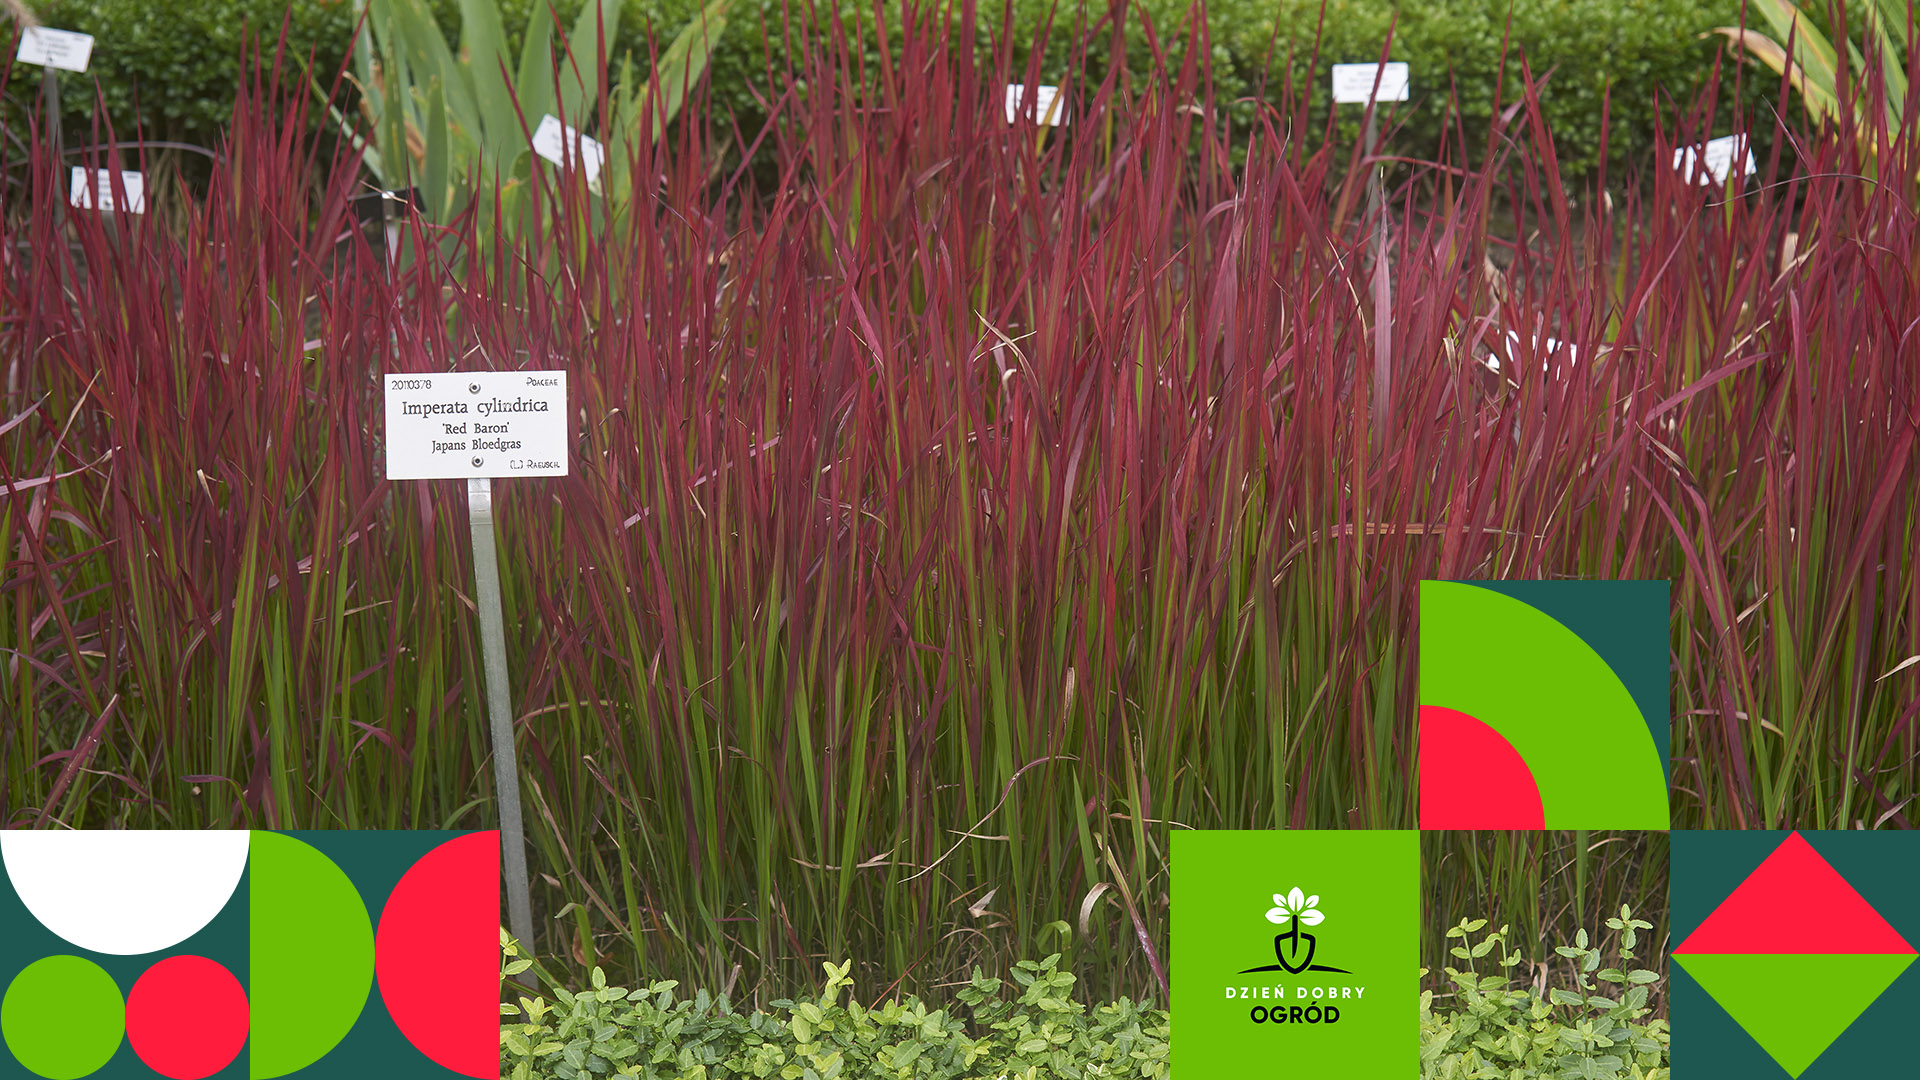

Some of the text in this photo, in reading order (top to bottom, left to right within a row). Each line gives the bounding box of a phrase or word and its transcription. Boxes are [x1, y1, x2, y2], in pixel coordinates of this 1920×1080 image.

[391, 379, 432, 390] 20110378
[402, 397, 549, 418] Imperata cylindrica
[431, 438, 522, 454] Japans Bloedgras
